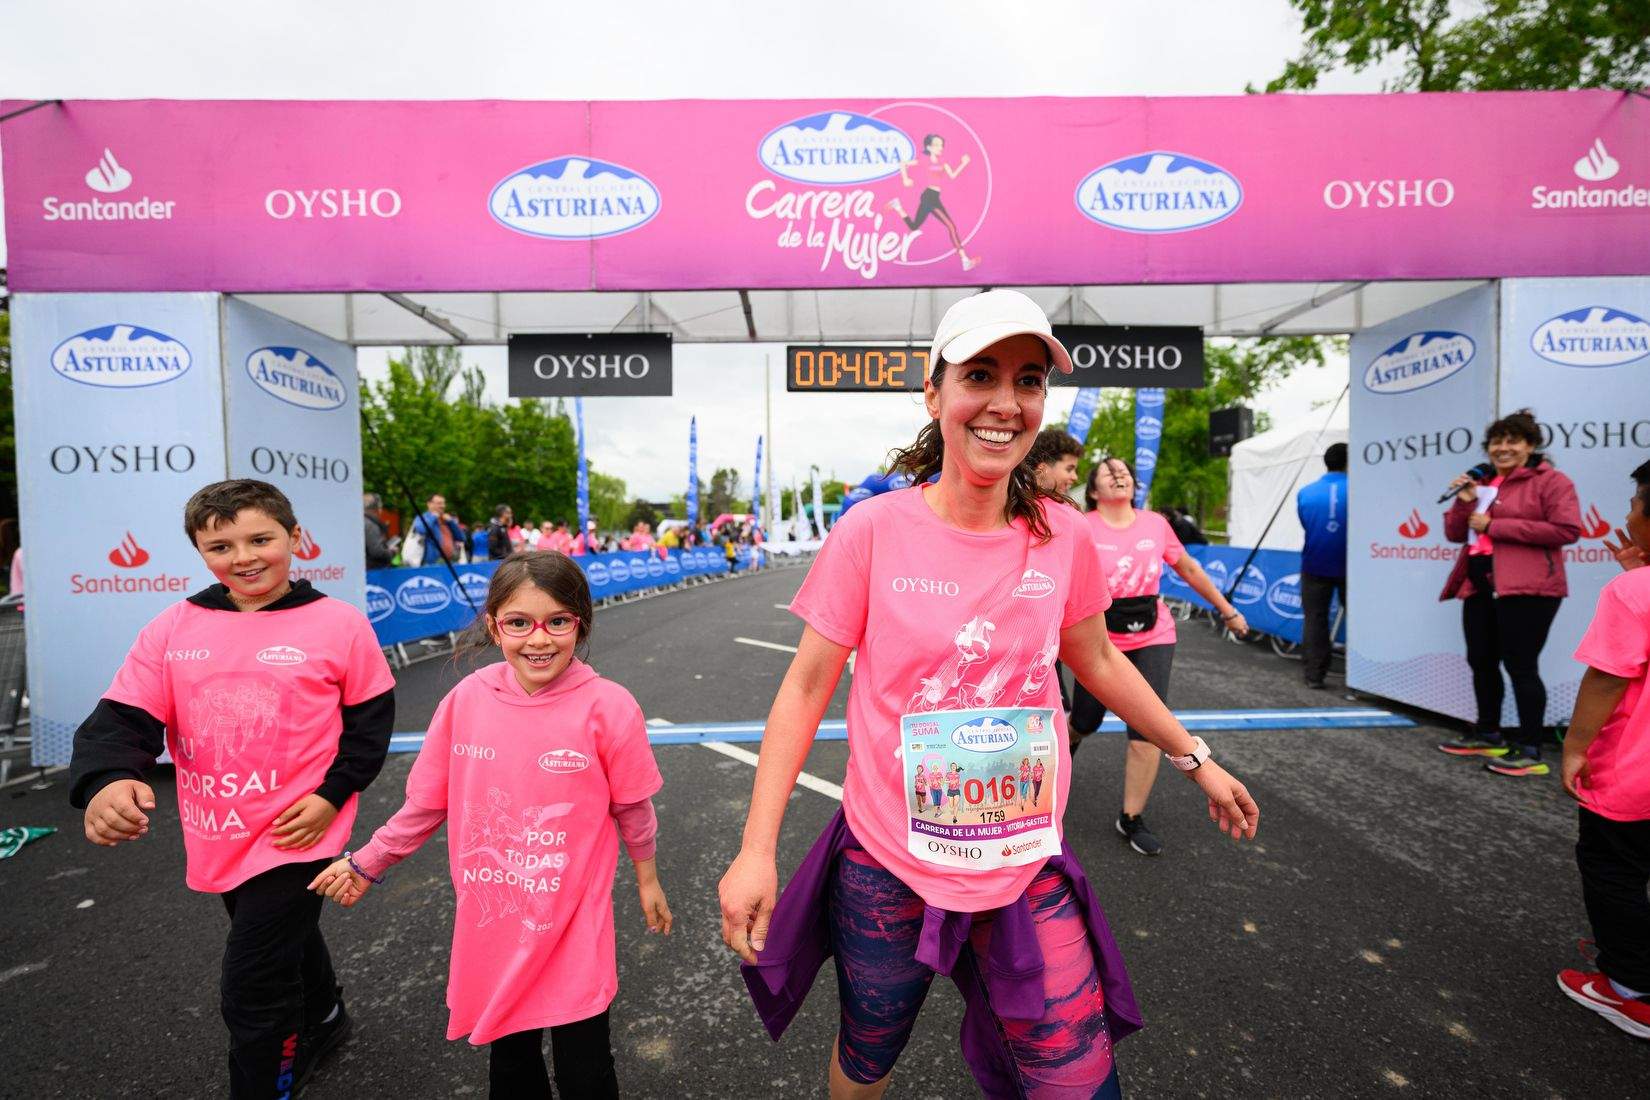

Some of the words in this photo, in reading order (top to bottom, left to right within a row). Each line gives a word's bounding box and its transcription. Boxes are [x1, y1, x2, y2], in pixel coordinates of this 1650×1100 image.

[772, 140, 902, 166] ASTURIANA
[264, 188, 402, 219] OYSHO
[504, 189, 647, 218] ASTURIANA
[745, 179, 876, 220] Carrera
[1090, 183, 1229, 212] ASTURIANA
[1323, 178, 1454, 210] OYSHO
[1532, 185, 1650, 209] Santande
[43, 196, 176, 221] Santander
[777, 221, 803, 248] de
[807, 218, 825, 248] la
[820, 213, 923, 280] Mujer
[1541, 328, 1649, 352] ASTURIANA
[63, 349, 182, 373] ASTURIANA
[533, 354, 650, 379] OYSHO
[795, 351, 930, 387] 00:40:27
[1072, 343, 1182, 370] OYSHO
[1370, 348, 1466, 387] ASTURIANA
[255, 357, 341, 402] ASTURIANA
[50, 444, 195, 474] OYSHO
[1363, 427, 1473, 466] OYSHO
[251, 447, 349, 483] OYSHO
[1370, 543, 1460, 561] Santander
[70, 574, 191, 594] Santander
[892, 577, 960, 597] OYSHO
[164, 649, 210, 661] YSHO
[957, 731, 1015, 745] ASTURIANA
[453, 743, 496, 760] OYHO
[181, 769, 283, 800] DORSAL
[964, 775, 1016, 804] 016
[184, 800, 246, 832] SUMA
[915, 821, 950, 836] CARRERA
[952, 828, 964, 837] DE
[965, 828, 976, 837] LA
[977, 827, 1003, 836] MUJER
[980, 810, 1006, 824] 1759
[526, 831, 567, 846] POR
[928, 841, 982, 859] OYSHO
[505, 849, 565, 870] TODAS
